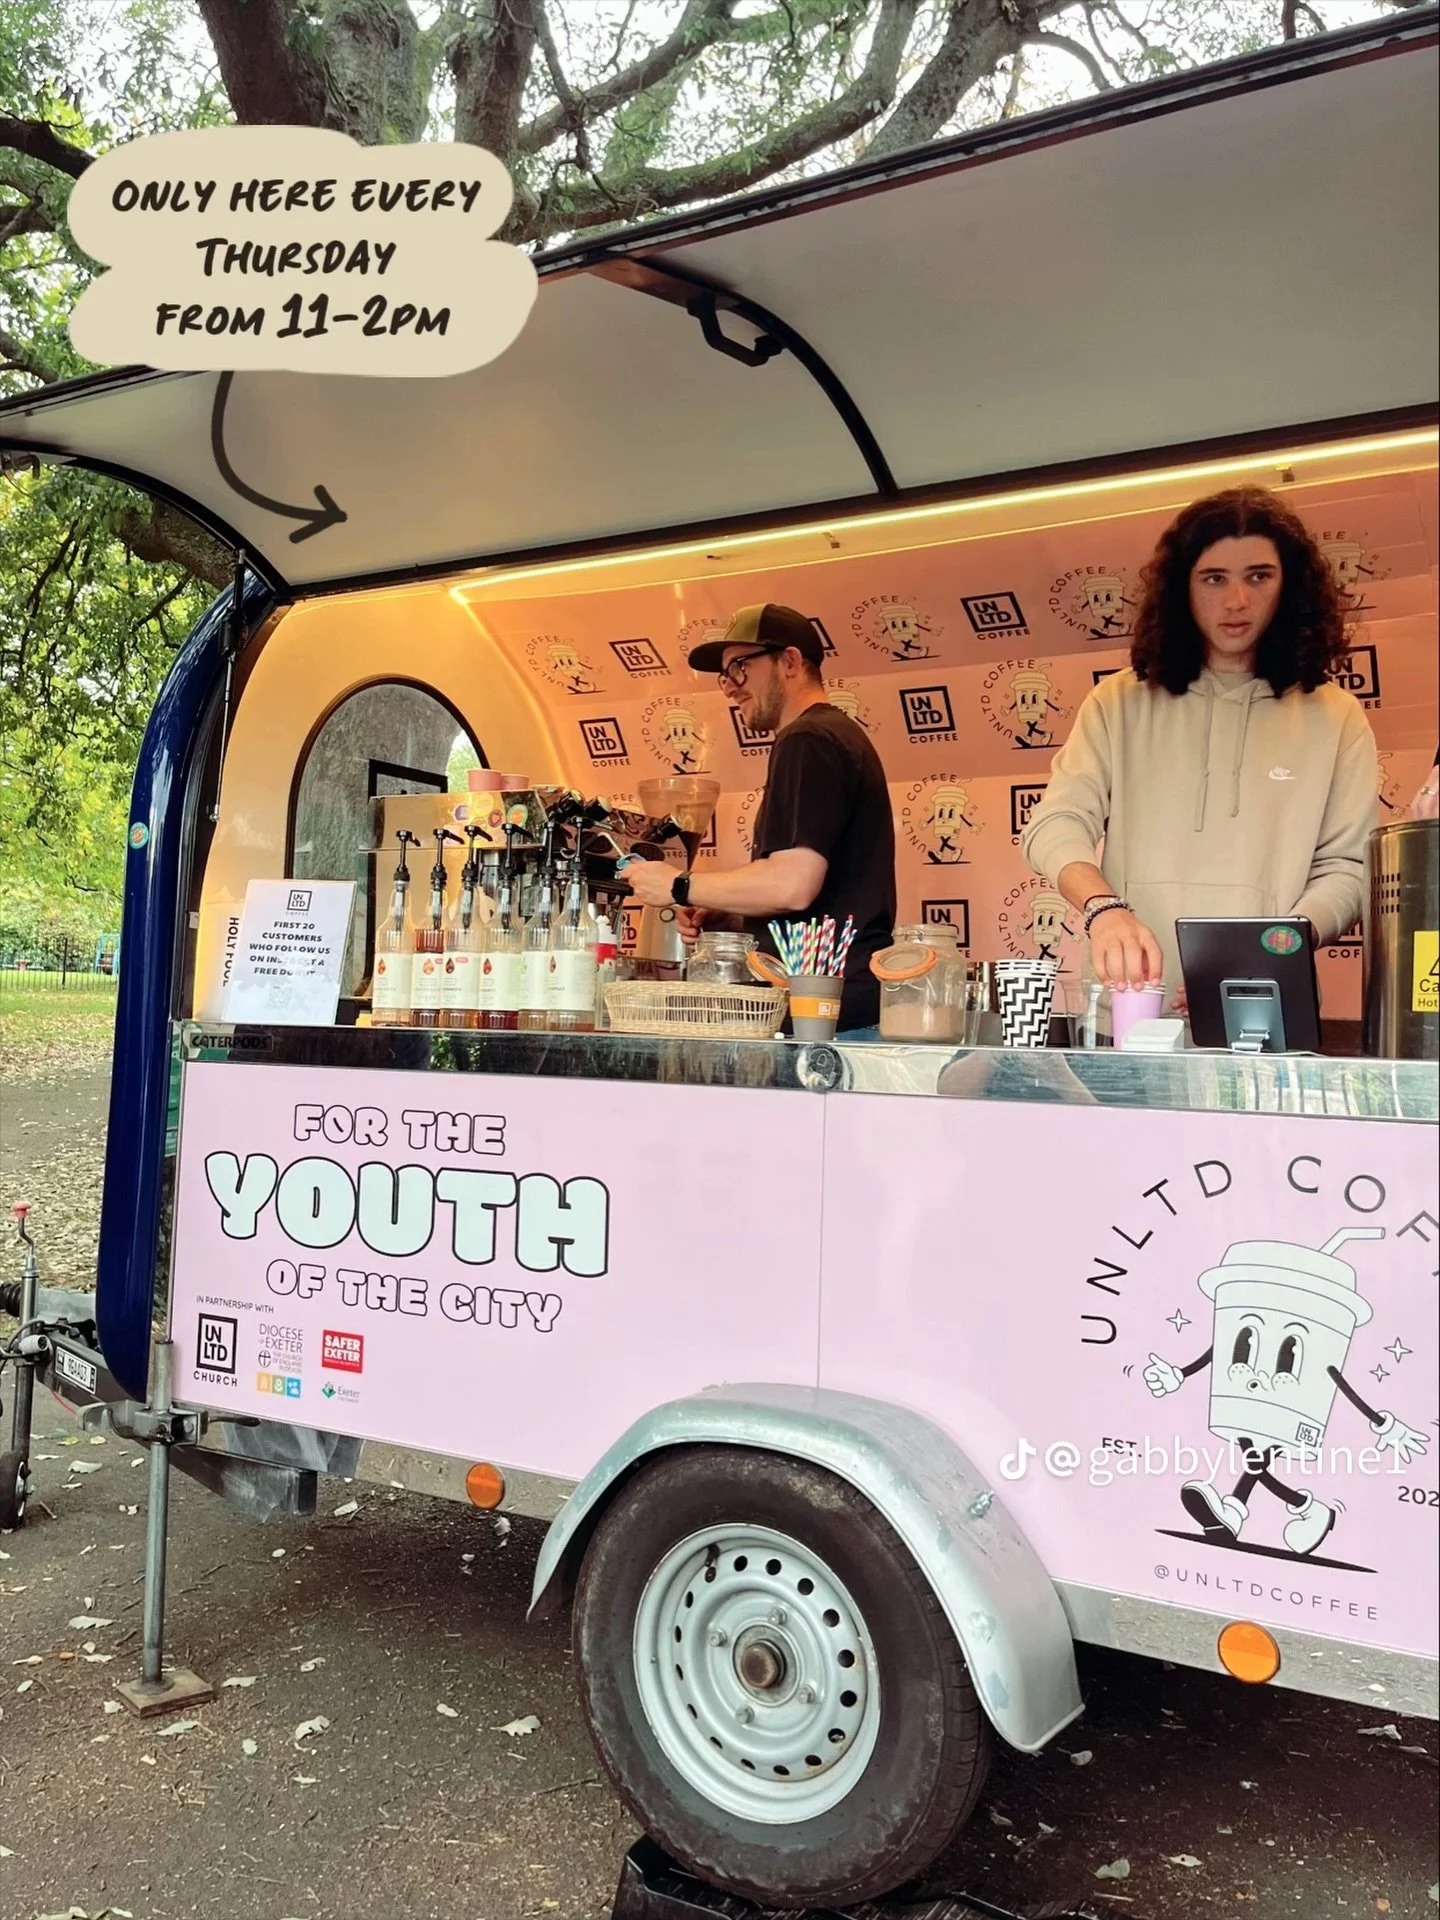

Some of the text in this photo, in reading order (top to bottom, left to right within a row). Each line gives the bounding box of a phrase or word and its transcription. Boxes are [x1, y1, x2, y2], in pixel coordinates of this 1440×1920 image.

[973, 600, 999, 614] UN
[1048, 566, 1107, 634] UNLTD COFFEE
[851, 594, 900, 655] UNLTD COFFEE
[978, 611, 1012, 625] LTD
[677, 618, 718, 641] COFFEE
[977, 628, 1031, 641] COFFEE
[525, 634, 560, 656] COFFEE
[620, 645, 643, 657] UN
[626, 655, 654, 667] LTD
[630, 669, 673, 679] COFFEE
[1330, 673, 1365, 690] TD
[910, 696, 933, 711] UN
[980, 658, 1036, 740] UNLTD COFFEE
[913, 708, 943, 726] LTD
[588, 725, 607, 739] UN
[641, 696, 681, 766] UNLTD COFFEE
[909, 732, 959, 745] COFFEE
[592, 738, 618, 752] LTD
[741, 748, 770, 757] COFF
[592, 757, 631, 768] COFFEE
[902, 773, 958, 854] UNLTD COFFEE
[291, 900, 306, 908] LTD
[274, 920, 300, 930] FIRST
[931, 909, 951, 924] UN
[226, 917, 240, 951] HOLY
[262, 932, 323, 943] CUSTOMERS
[249, 943, 273, 951] WHO
[318, 947, 331, 955] US
[249, 955, 265, 963] ON
[254, 967, 279, 976] FREE
[1417, 998, 1438, 1008] Hot
[294, 1103, 506, 1156] FOR THE
[204, 1151, 610, 1278] YOUTH
[1081, 1155, 1439, 1345] UNLTD COF
[266, 1258, 563, 1333] OF THE CITY
[196, 1295, 275, 1314] IN PARTNERSHIP WITH
[205, 1323, 222, 1343] UN
[259, 1323, 303, 1341] DIOCESE
[265, 1336, 303, 1354] EXETER
[324, 1334, 360, 1352] SAFER
[204, 1342, 227, 1362] LTD
[323, 1347, 360, 1363] EXETER
[193, 1370, 238, 1387] CHURCH
[337, 1385, 360, 1399] Exeter
[1398, 1485, 1439, 1507] 202
[1154, 1564, 1379, 1621] @UNLTDCOFFEE
